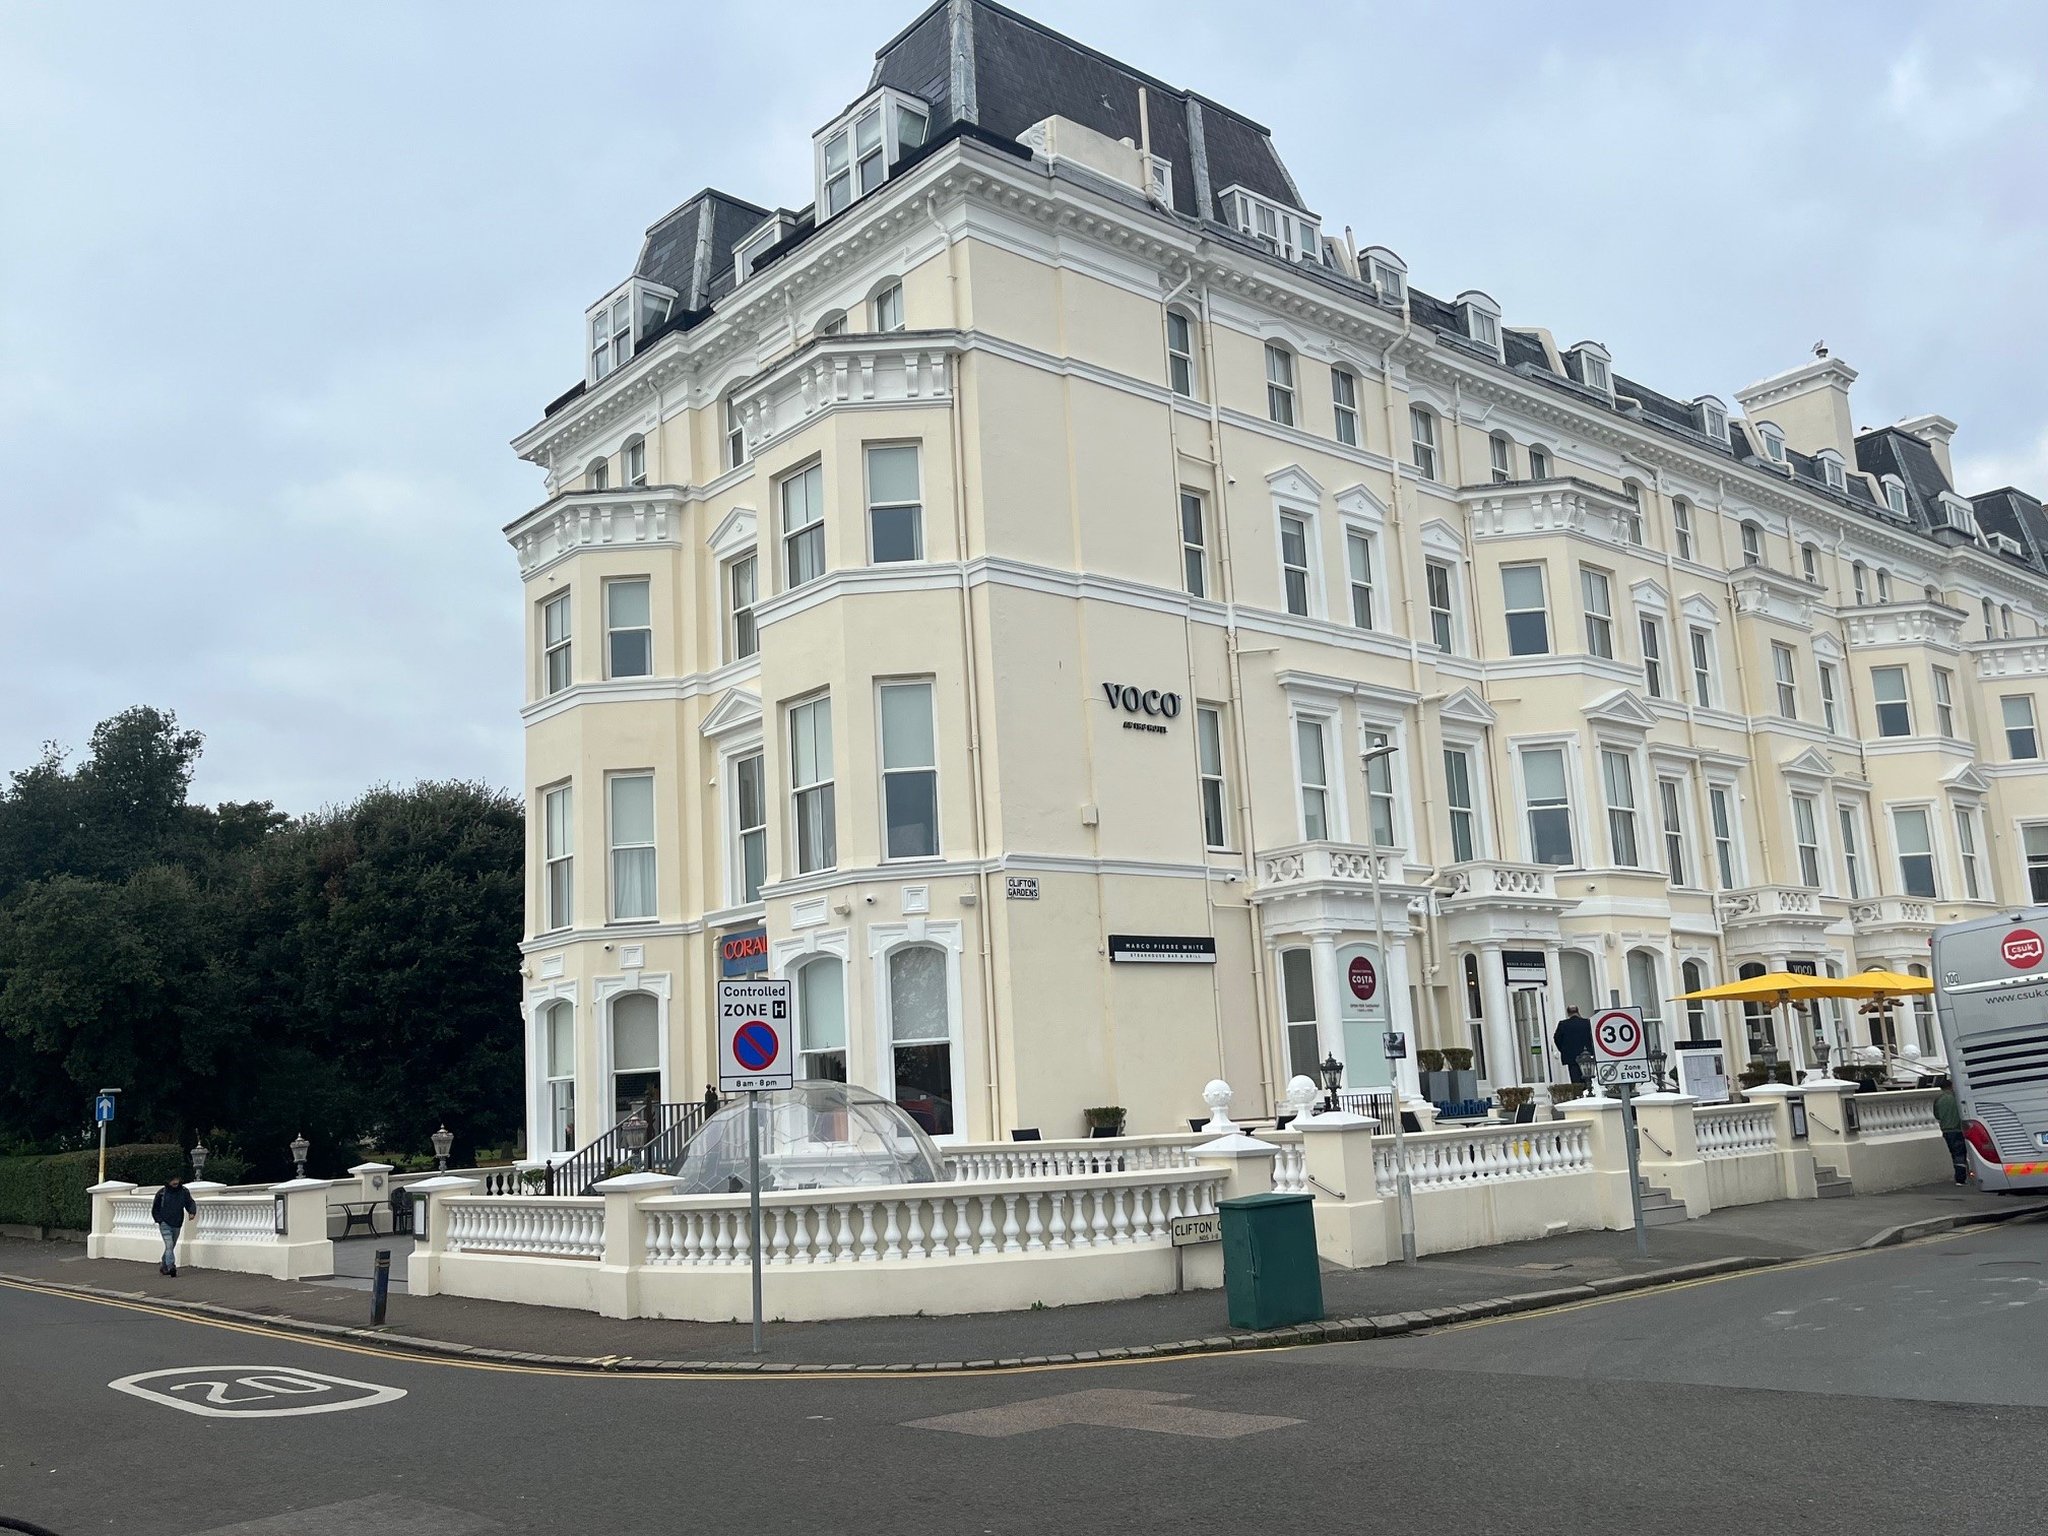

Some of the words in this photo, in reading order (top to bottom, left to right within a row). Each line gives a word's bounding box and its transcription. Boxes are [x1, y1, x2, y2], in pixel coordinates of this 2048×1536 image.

[1008, 879, 1037, 888] CLIFTON
[1008, 888, 1038, 897] GARDENS
[2011, 943, 2034, 953] csuk
[1351, 975, 1374, 984] COSTA
[1946, 973, 1960, 985] 100
[724, 986, 785, 997] Controlled
[724, 1003, 768, 1017] ZONE
[774, 1002, 785, 1017] H
[1602, 1024, 1635, 1043] 30
[1602, 1068, 1615, 1077] 20
[1621, 1071, 1647, 1080] ENDS
[1467, 1098, 1491, 1115] Hote
[1174, 1221, 1212, 1237] CLIFTON
[170, 1375, 331, 1404] 20
